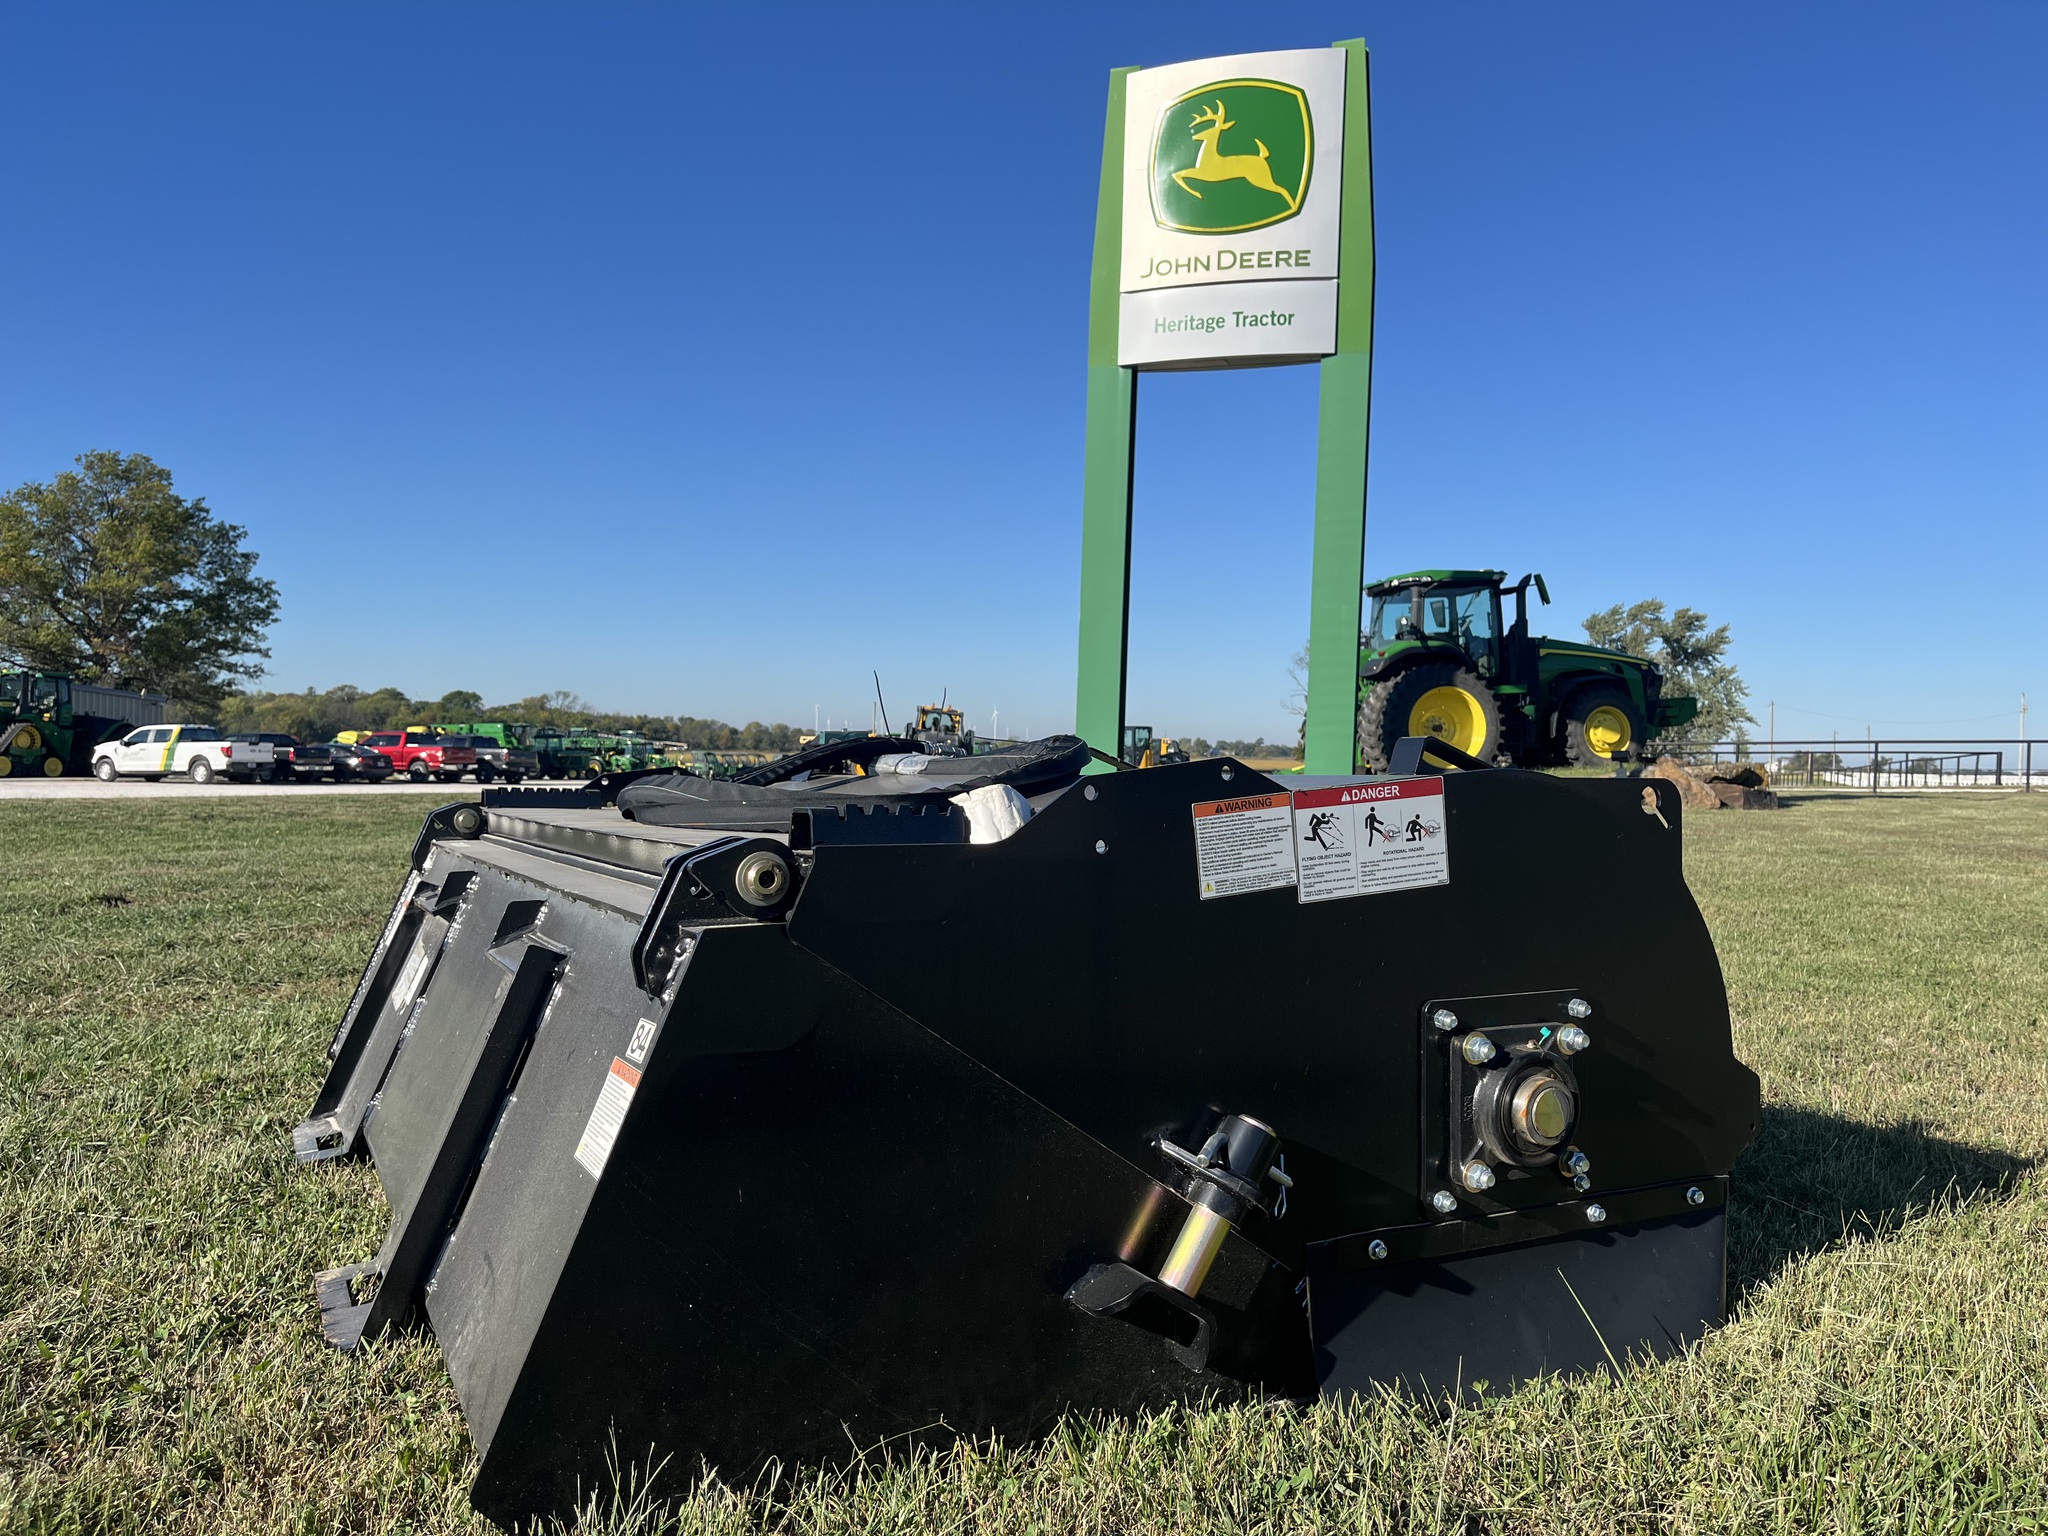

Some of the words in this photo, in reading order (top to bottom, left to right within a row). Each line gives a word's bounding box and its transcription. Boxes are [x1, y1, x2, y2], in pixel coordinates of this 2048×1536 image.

[1140, 254, 1211, 279] JOHN
[1217, 249, 1311, 271] DEERE
[1154, 314, 1226, 334] Heritage
[1232, 310, 1295, 328] Tractor
[1352, 785, 1400, 801] DANGER
[1224, 797, 1272, 812] WARNING
[1383, 848, 1407, 856] ROTATIONAL
[630, 1023, 652, 1058] 84
